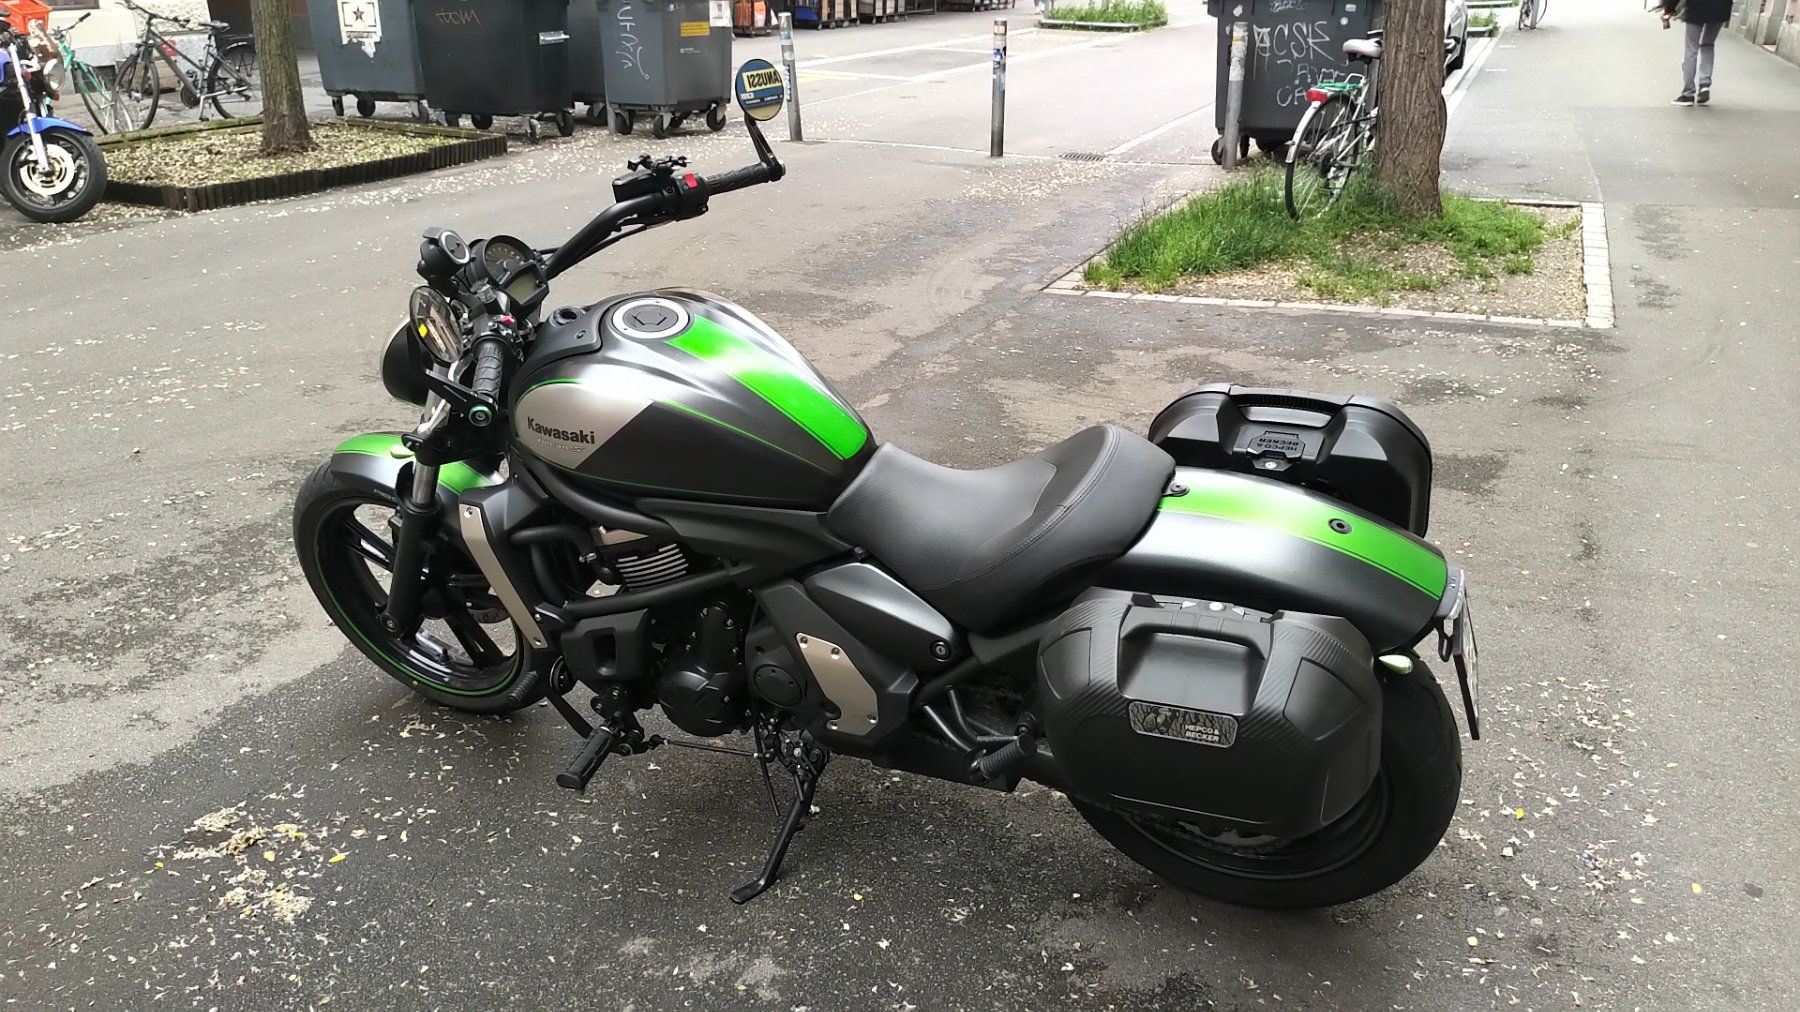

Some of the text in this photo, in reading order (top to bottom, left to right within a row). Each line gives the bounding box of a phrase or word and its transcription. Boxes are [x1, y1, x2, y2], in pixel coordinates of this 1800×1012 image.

[527, 416, 595, 444] Kawasaki
[1259, 438, 1299, 446] BECKER
[1264, 443, 1298, 451] HEPCO
[1185, 724, 1213, 734] HEPCO
[1185, 730, 1219, 741] BECKER
